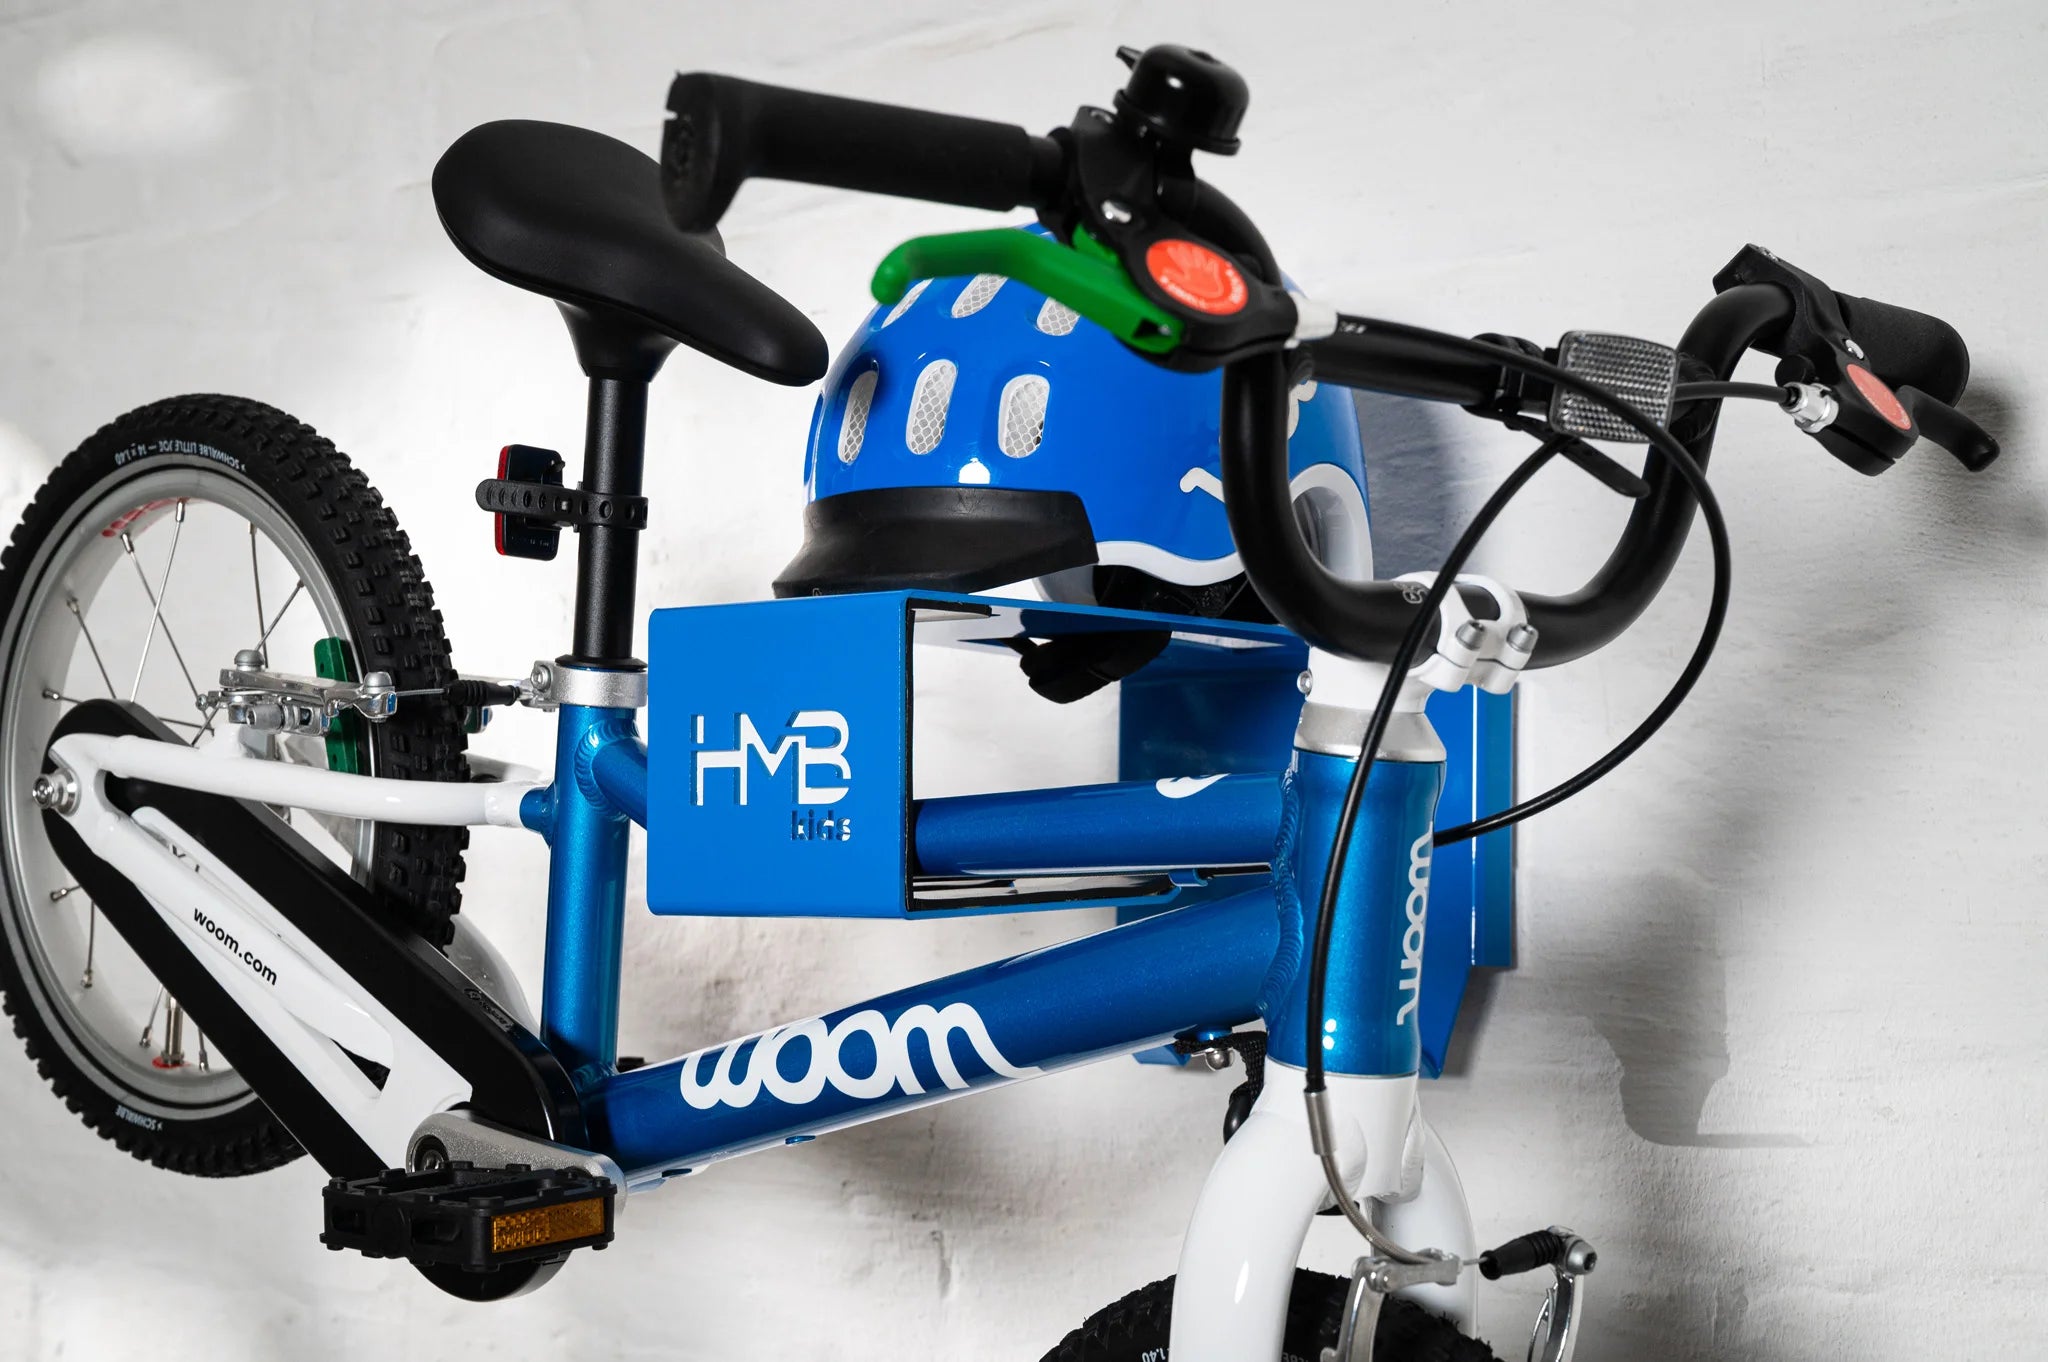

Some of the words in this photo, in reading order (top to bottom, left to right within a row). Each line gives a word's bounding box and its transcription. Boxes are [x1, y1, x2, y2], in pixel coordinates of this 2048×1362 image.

[114, 449, 131, 465] 1.40
[159, 440, 173, 453] JOE
[174, 440, 198, 454] LITTLE
[199, 444, 240, 469] SCHWALBE
[690, 710, 852, 806] HMB
[790, 809, 851, 841] kids
[1396, 820, 1434, 1026] woom
[193, 907, 277, 986] woom.com
[679, 1002, 1043, 1110] woom
[1141, 1347, 1166, 1362] 1.40
